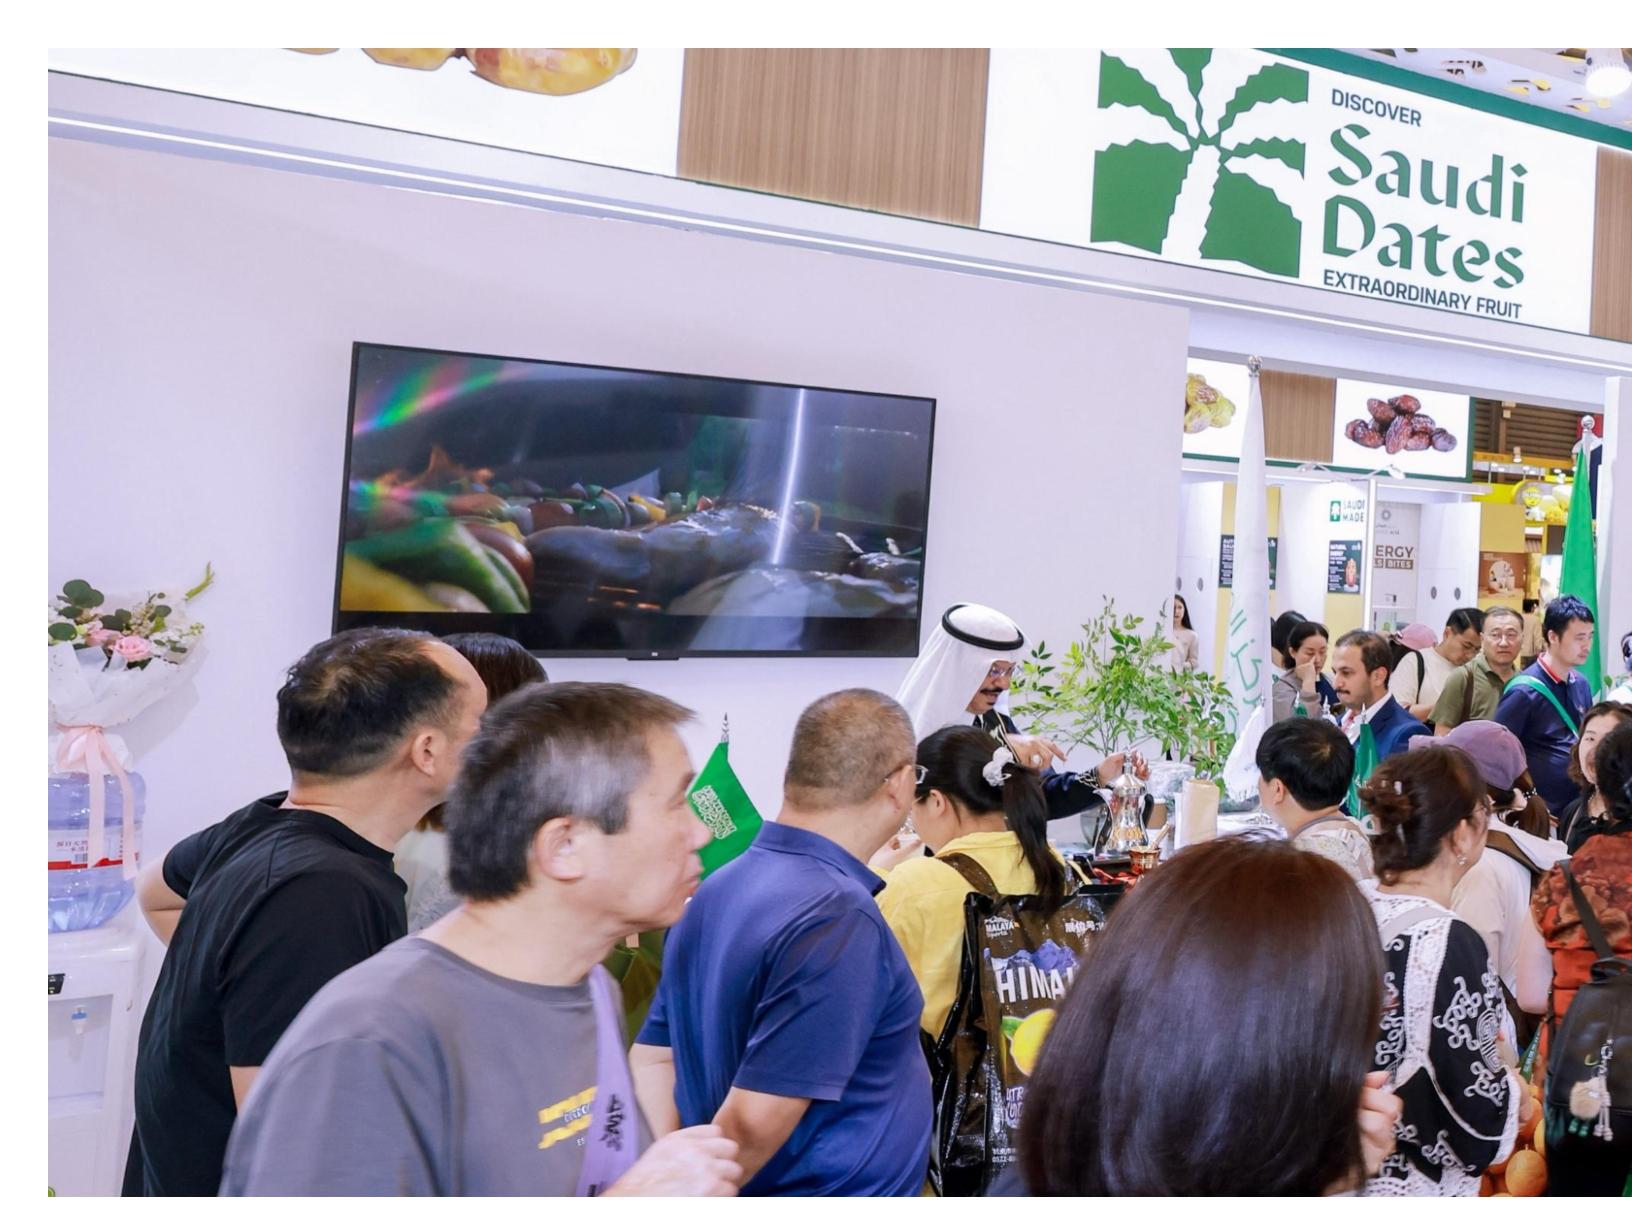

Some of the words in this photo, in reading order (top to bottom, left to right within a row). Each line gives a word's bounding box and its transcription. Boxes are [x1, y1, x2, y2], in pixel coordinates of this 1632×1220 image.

[1331, 88, 1422, 128] DISCOVER
[1328, 123, 1528, 223] Saudi
[1323, 194, 1525, 289] Dates
[1323, 269, 1471, 311] EXTRAORDINARY
[1476, 296, 1522, 319] FRUIT
[1343, 511, 1364, 522] MADE
[1375, 545, 1415, 558] ERGY
